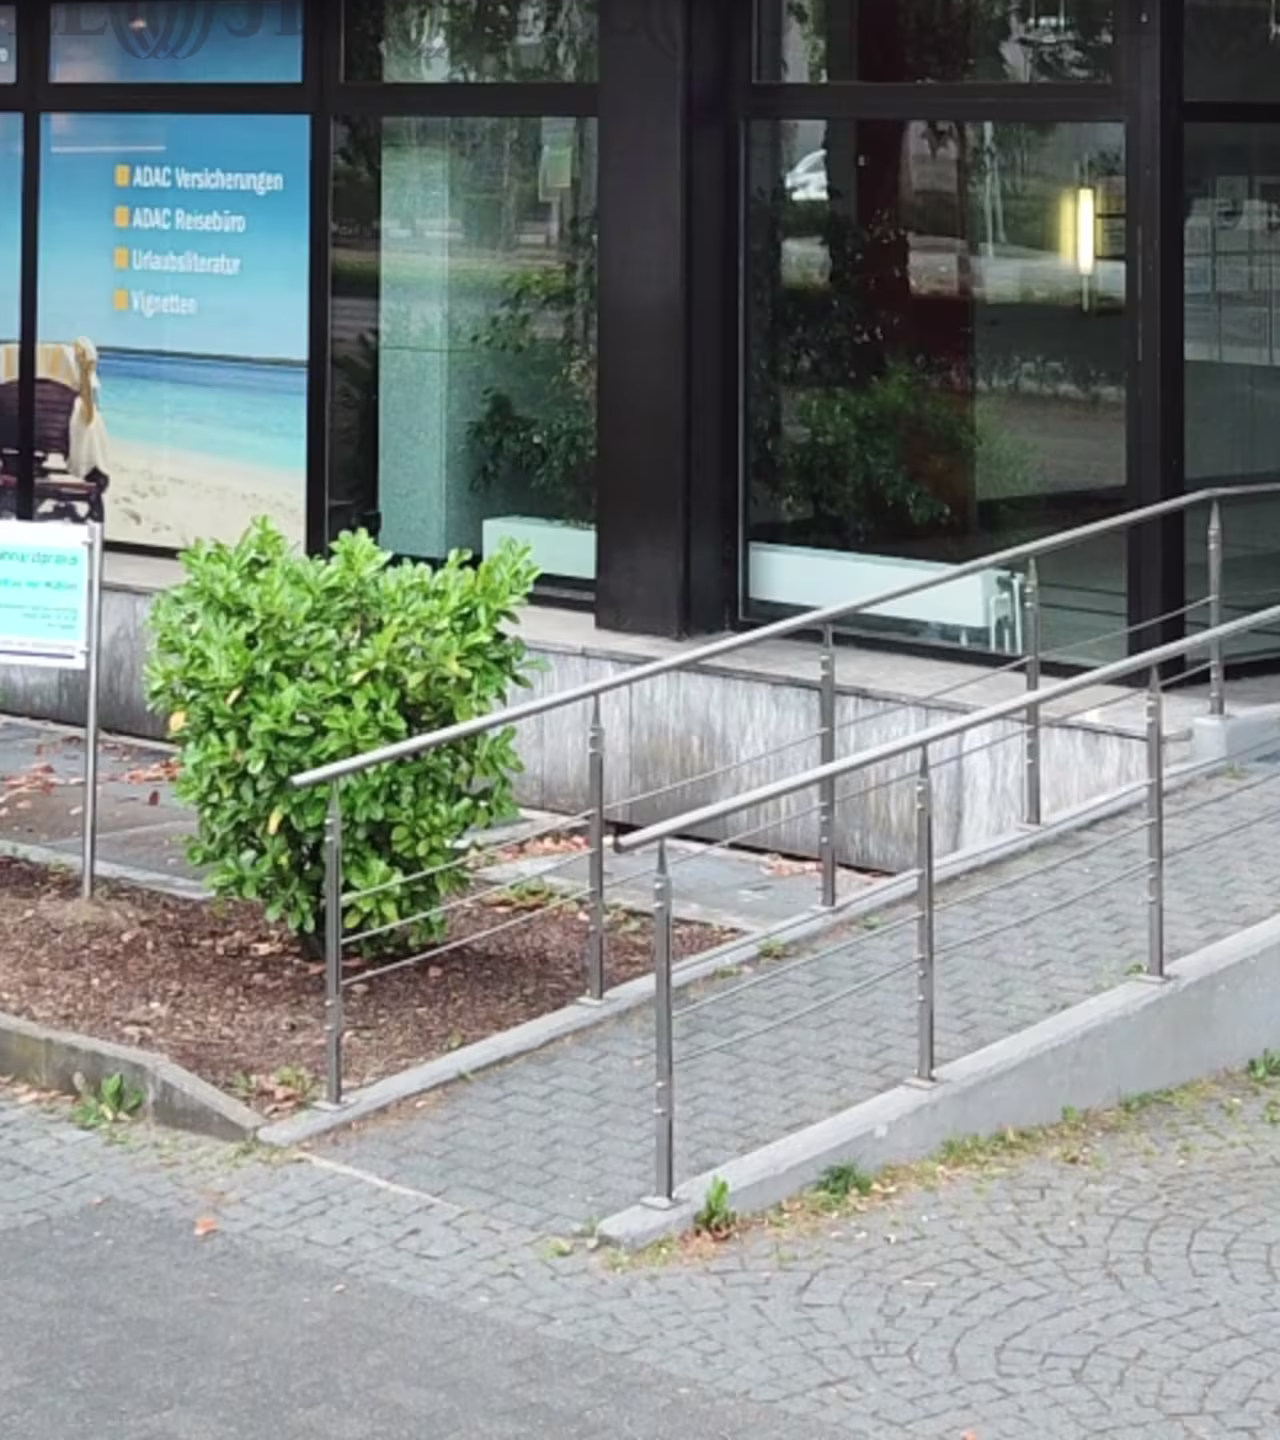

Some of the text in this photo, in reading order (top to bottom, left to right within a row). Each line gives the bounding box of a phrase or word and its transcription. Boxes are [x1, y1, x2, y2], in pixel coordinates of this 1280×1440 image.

[132, 165, 284, 196] ADAC Versicherungen
[132, 207, 247, 233] ADAC Reisebüro
[132, 249, 241, 275] Urlaubsliteratur
[131, 289, 199, 318] Vignetten
